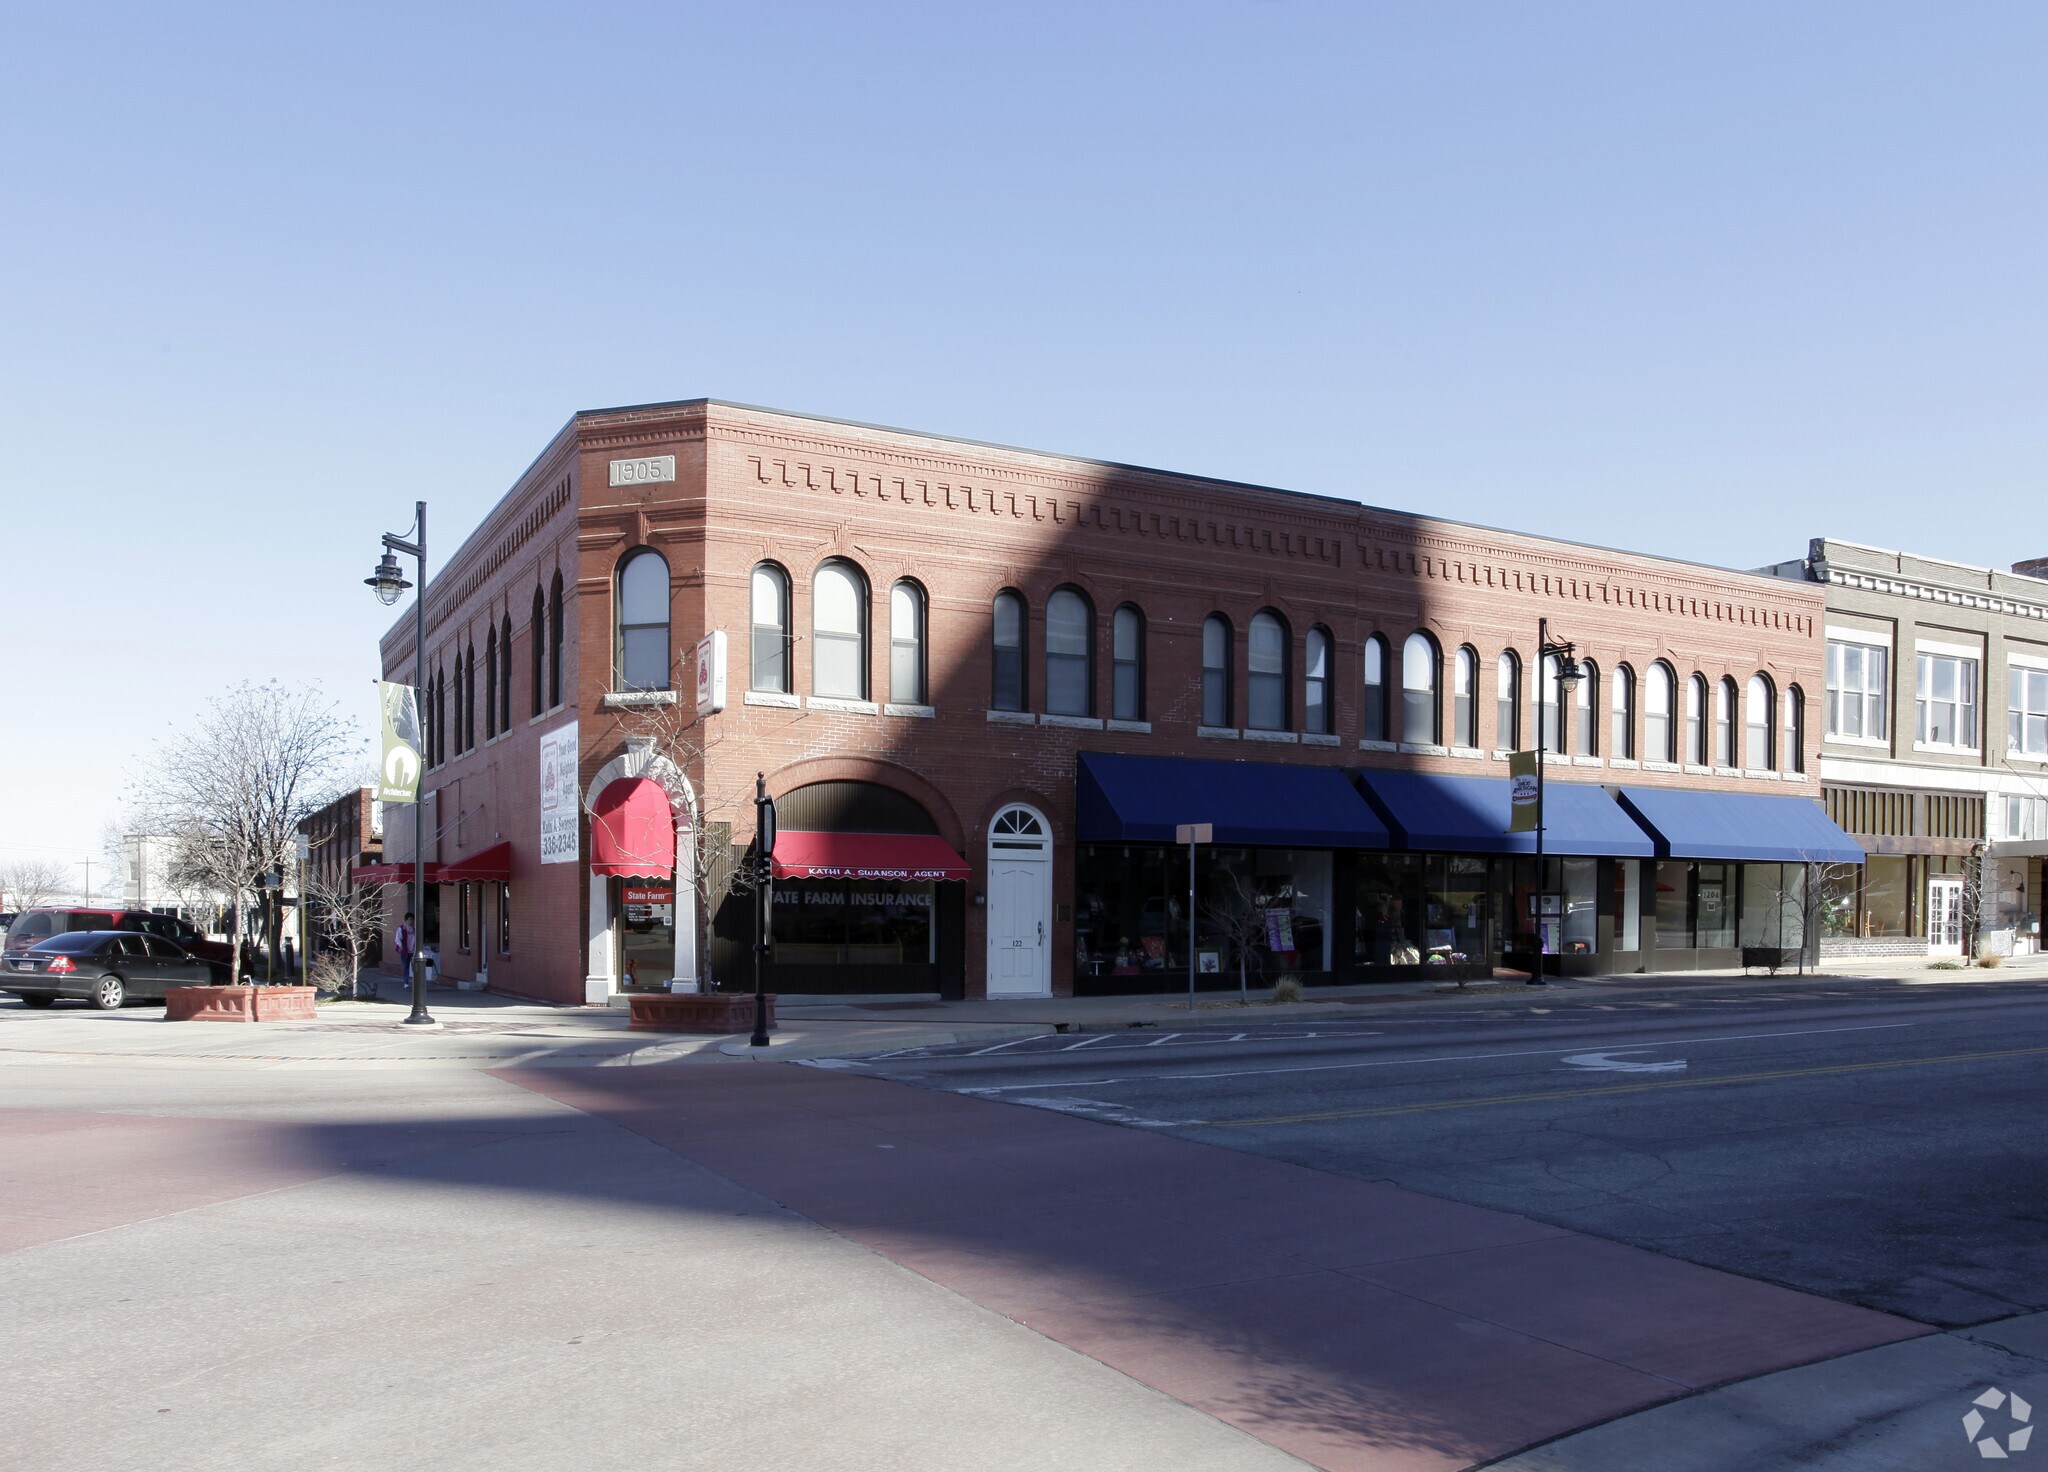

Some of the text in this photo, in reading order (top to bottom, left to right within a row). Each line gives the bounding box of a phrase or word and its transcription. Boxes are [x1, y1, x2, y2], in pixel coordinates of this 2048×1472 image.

[543, 832, 576, 855] 336-2345
[627, 891, 665, 900] State Farm
[804, 891, 845, 905] FARM
[851, 893, 932, 906] INSURANCE
